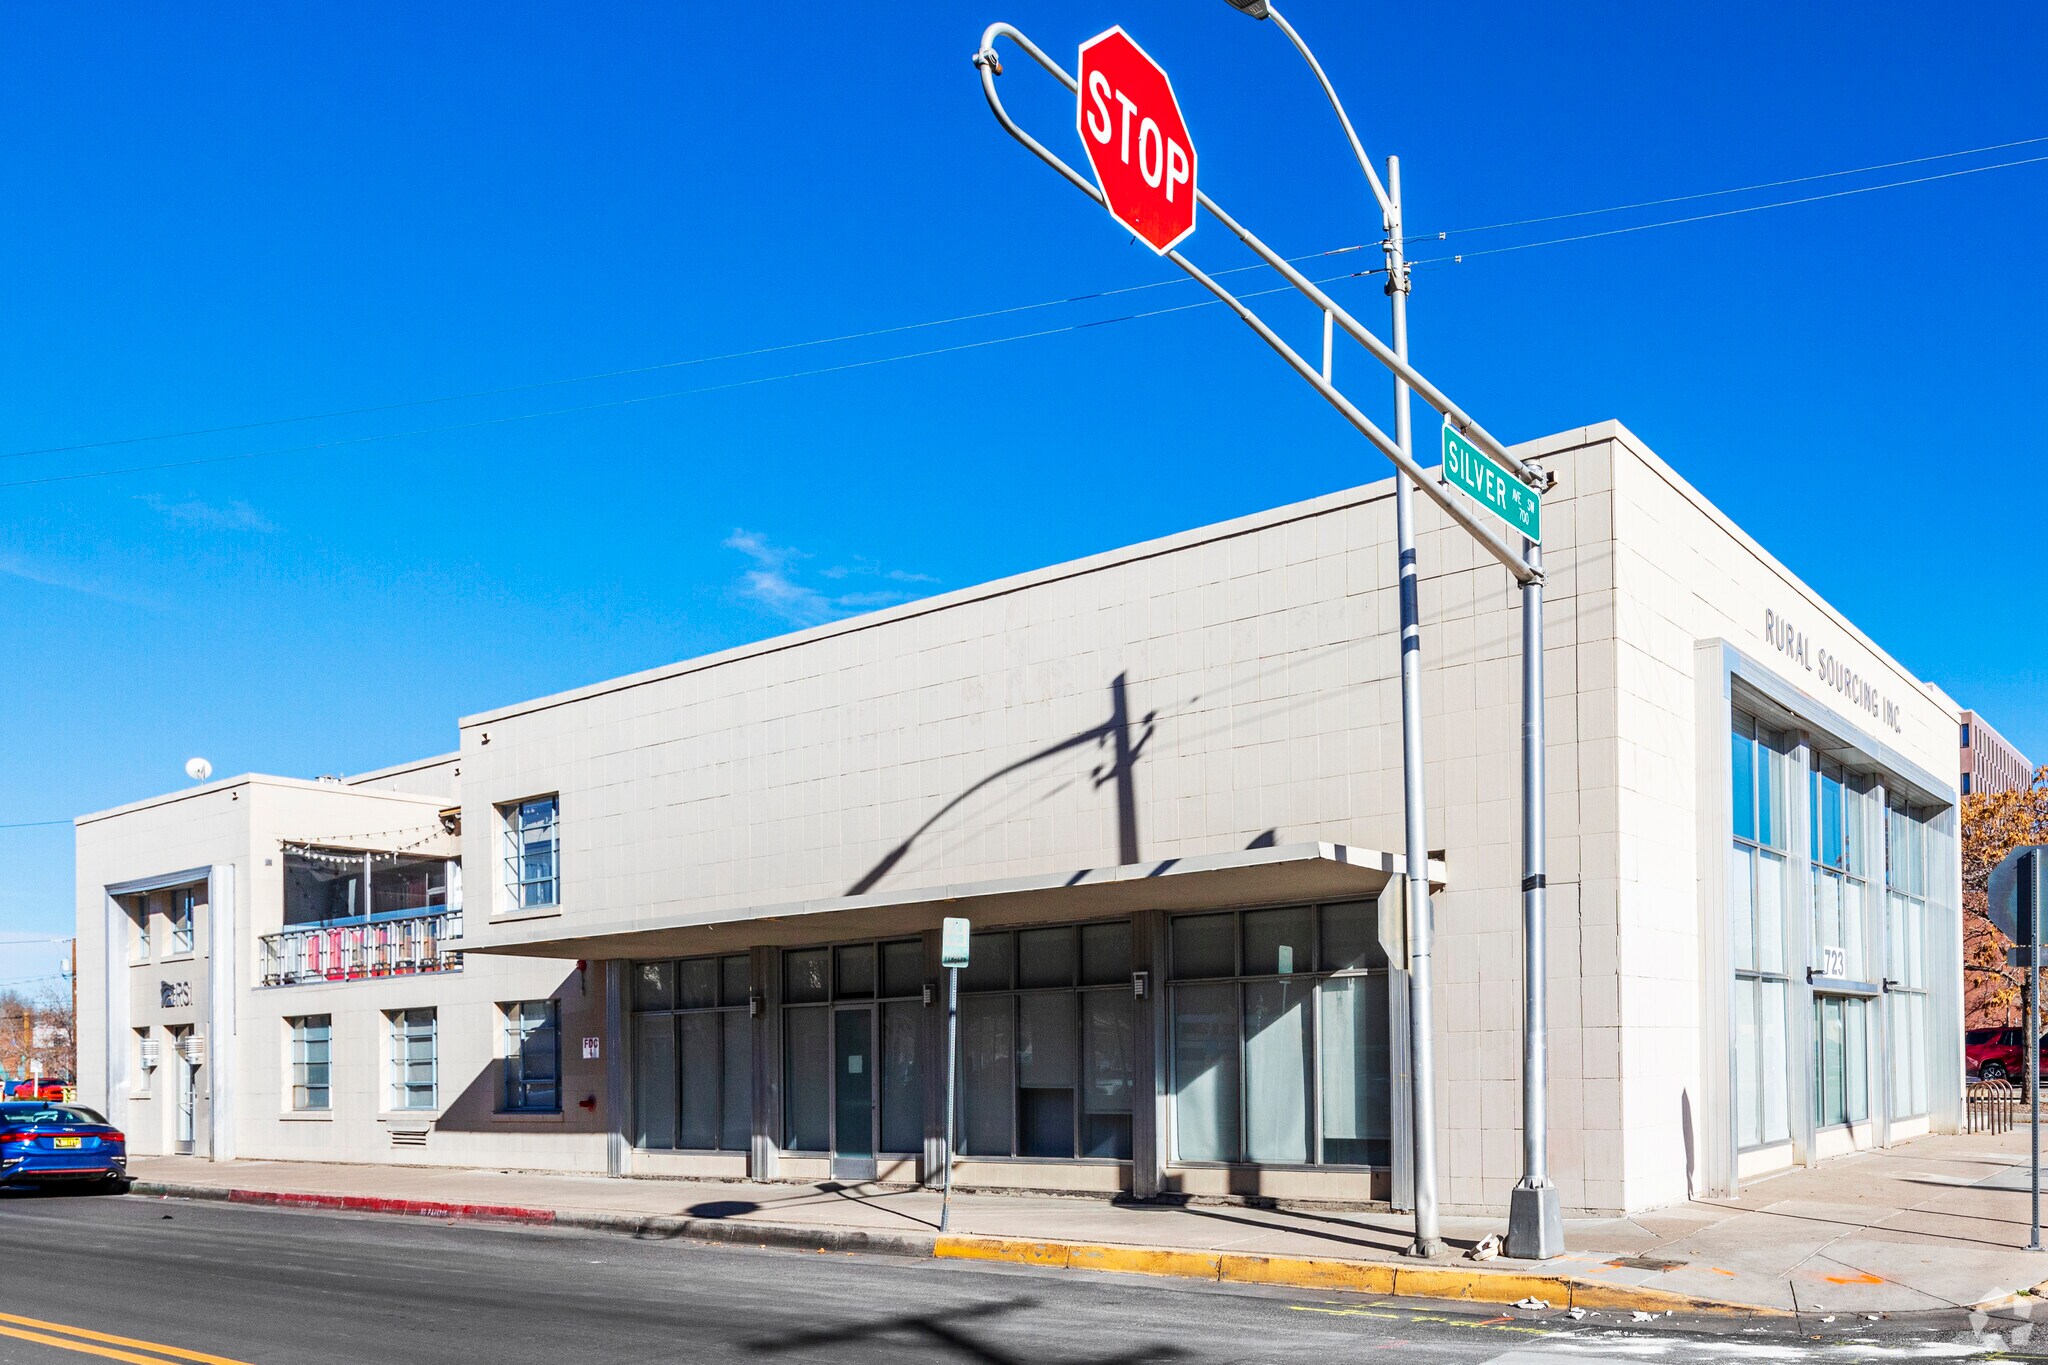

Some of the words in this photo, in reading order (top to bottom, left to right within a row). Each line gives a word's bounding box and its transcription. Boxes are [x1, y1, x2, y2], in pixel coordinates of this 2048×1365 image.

[1087, 70, 1189, 203] STOP
[1449, 440, 1506, 510] SILVER
[1512, 488, 1521, 505] AVE
[1527, 498, 1535, 514] SW
[1519, 507, 1529, 525] 700
[1765, 608, 1812, 671] RURAL
[1818, 648, 1878, 718] SOURCING
[1883, 696, 1901, 734] INC.
[1825, 949, 1844, 976] 723
[584, 1039, 598, 1048] FDC
